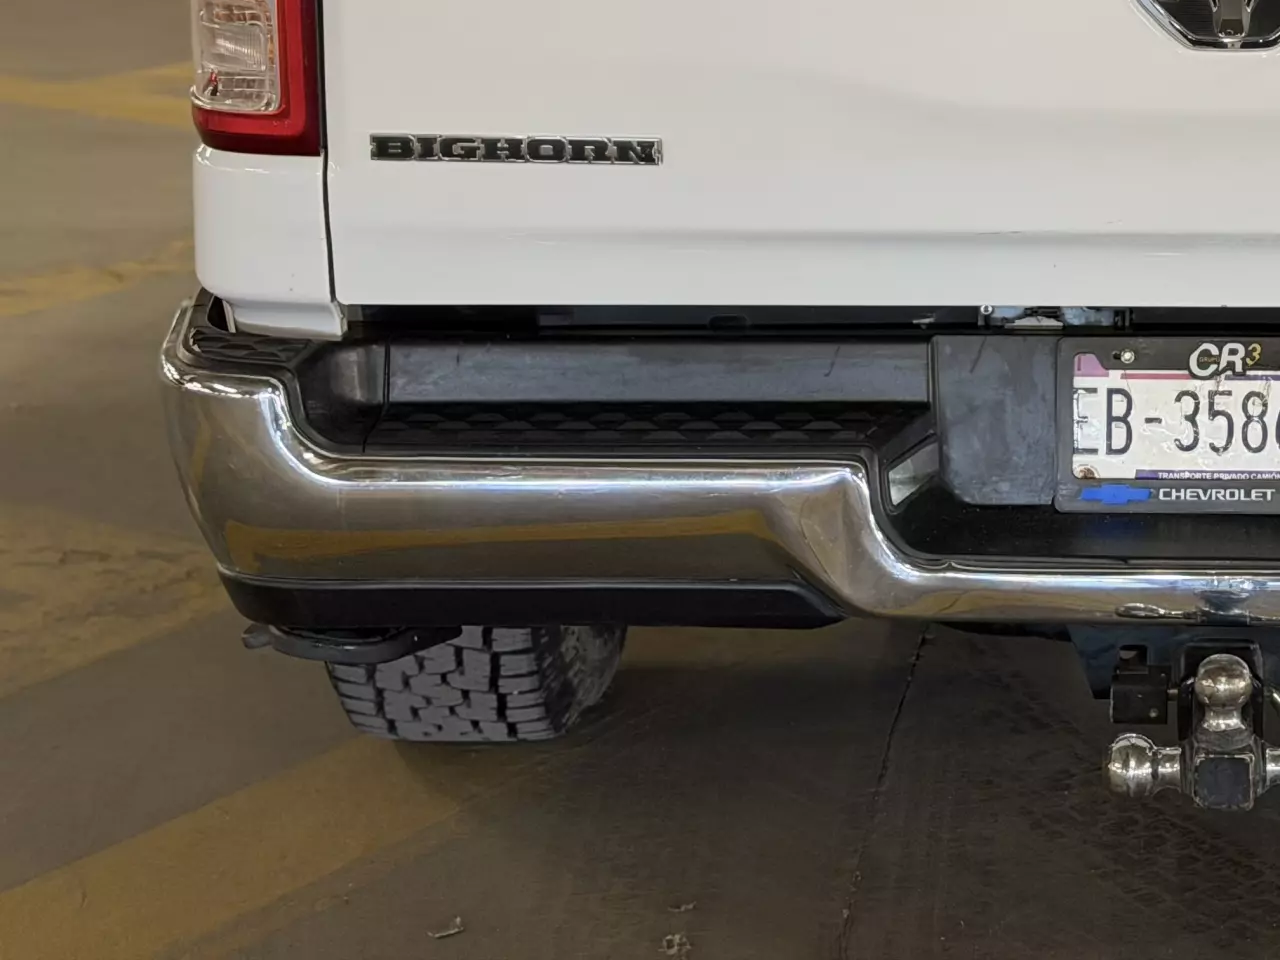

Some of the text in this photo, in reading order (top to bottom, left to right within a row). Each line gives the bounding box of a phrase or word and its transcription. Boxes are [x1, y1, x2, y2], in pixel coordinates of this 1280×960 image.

[370, 134, 662, 165] BIGHORN
[1157, 471, 1212, 480] TRANSPORTE
[1213, 471, 1250, 480] PRIVADO
[1158, 488, 1276, 501] CHEVROLET
